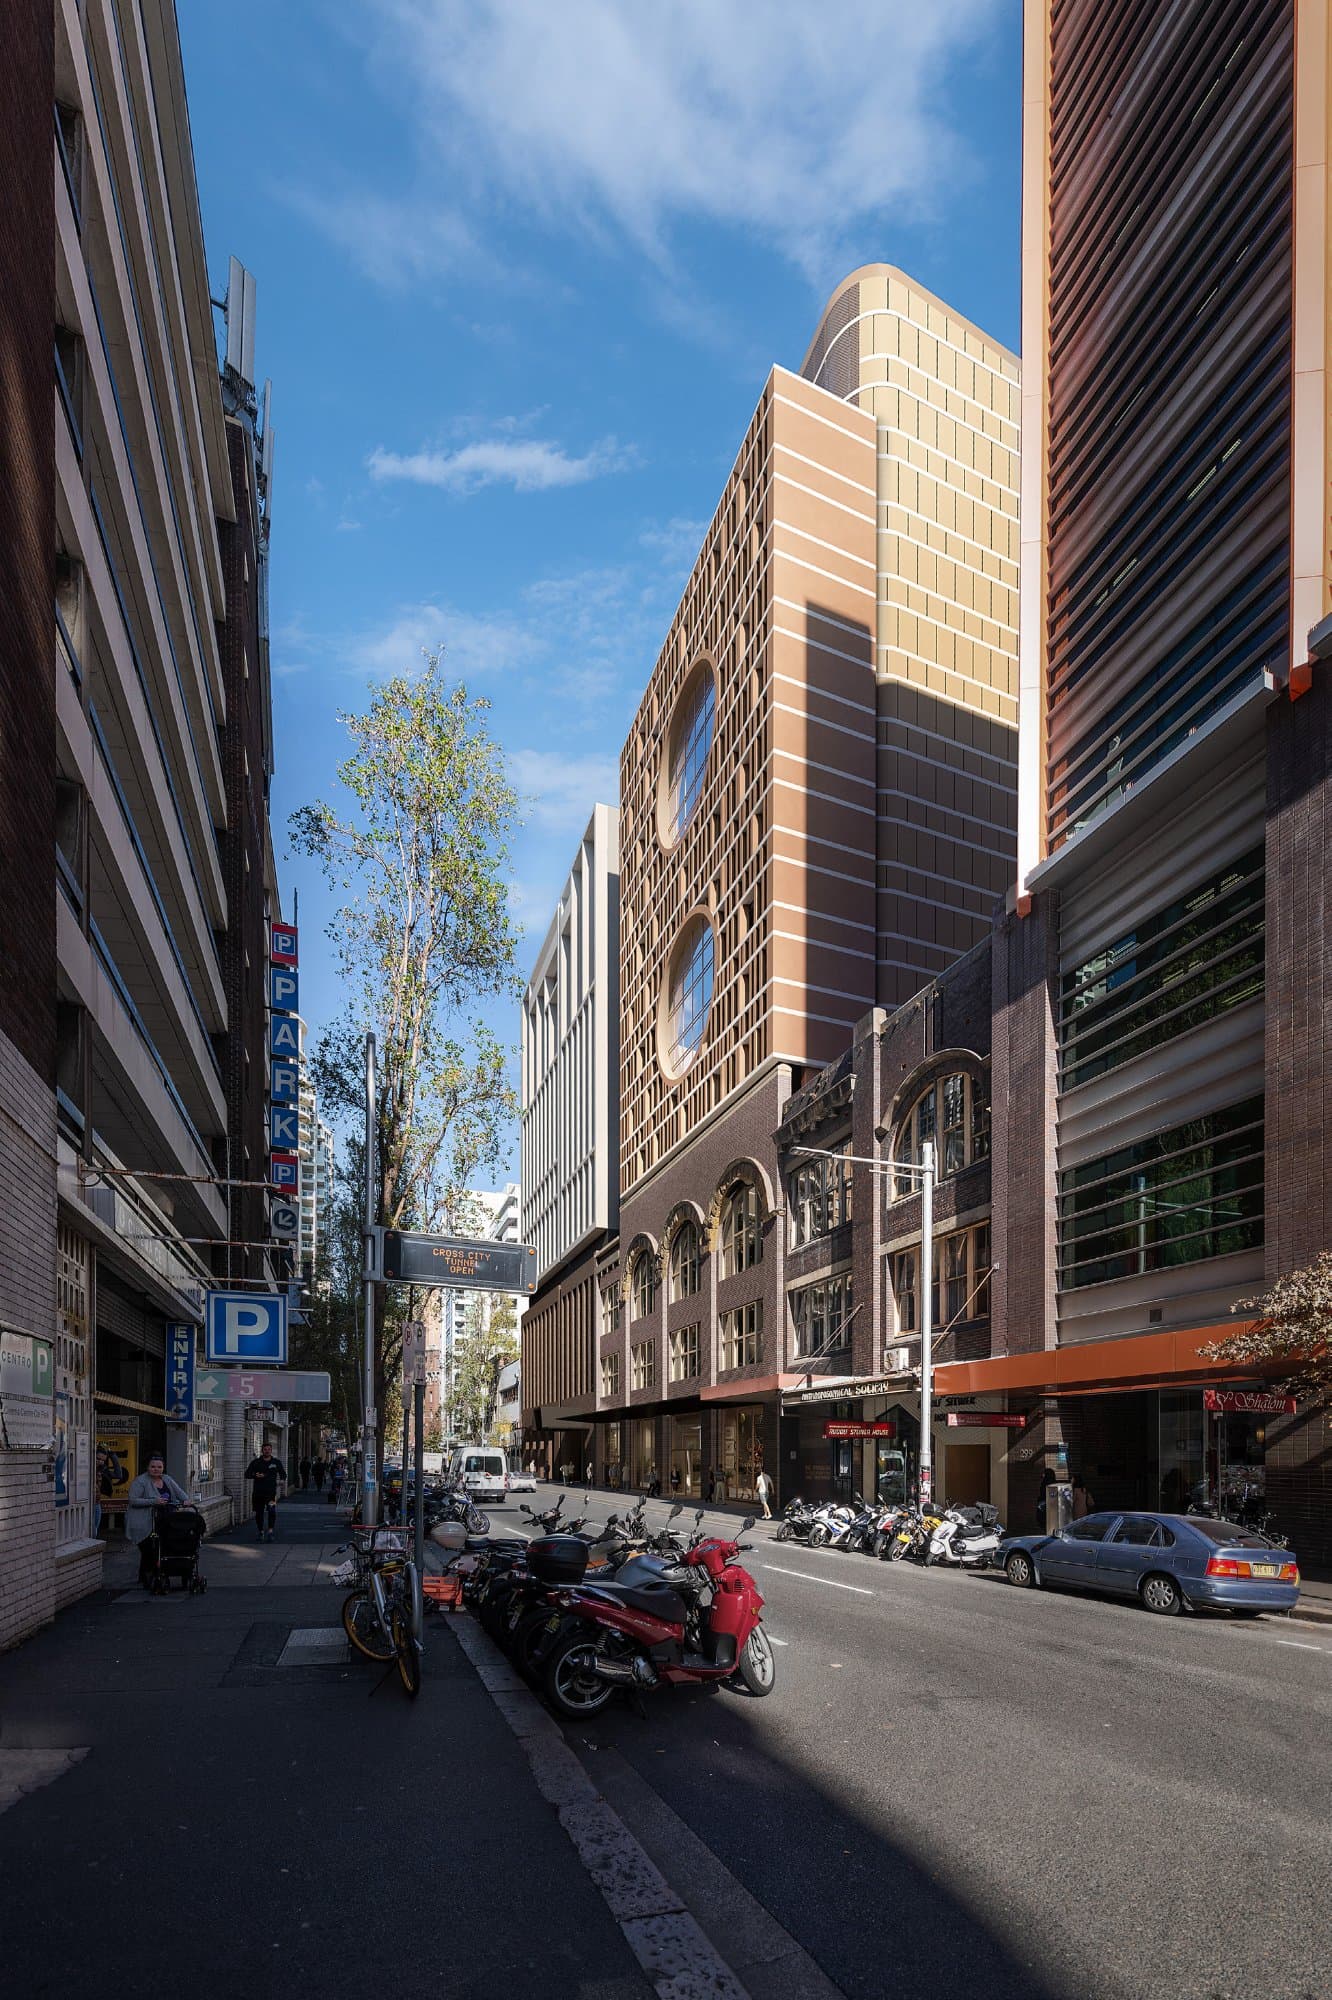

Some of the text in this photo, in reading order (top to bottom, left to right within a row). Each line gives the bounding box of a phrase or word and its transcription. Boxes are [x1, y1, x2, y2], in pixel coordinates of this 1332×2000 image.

[278, 936, 292, 951] P
[274, 976, 296, 1141] PARK
[277, 1165, 292, 1181] P
[432, 1248, 491, 1261] CROSS CITY
[445, 1257, 480, 1268] TUNNEL
[449, 1265, 474, 1275] OPEN
[225, 1302, 270, 1353] P
[1, 1346, 48, 1385] CENTRO P
[172, 1326, 189, 1400] ENTRY
[239, 1376, 254, 1396] 5
[1234, 1392, 1287, 1410] Shalom
